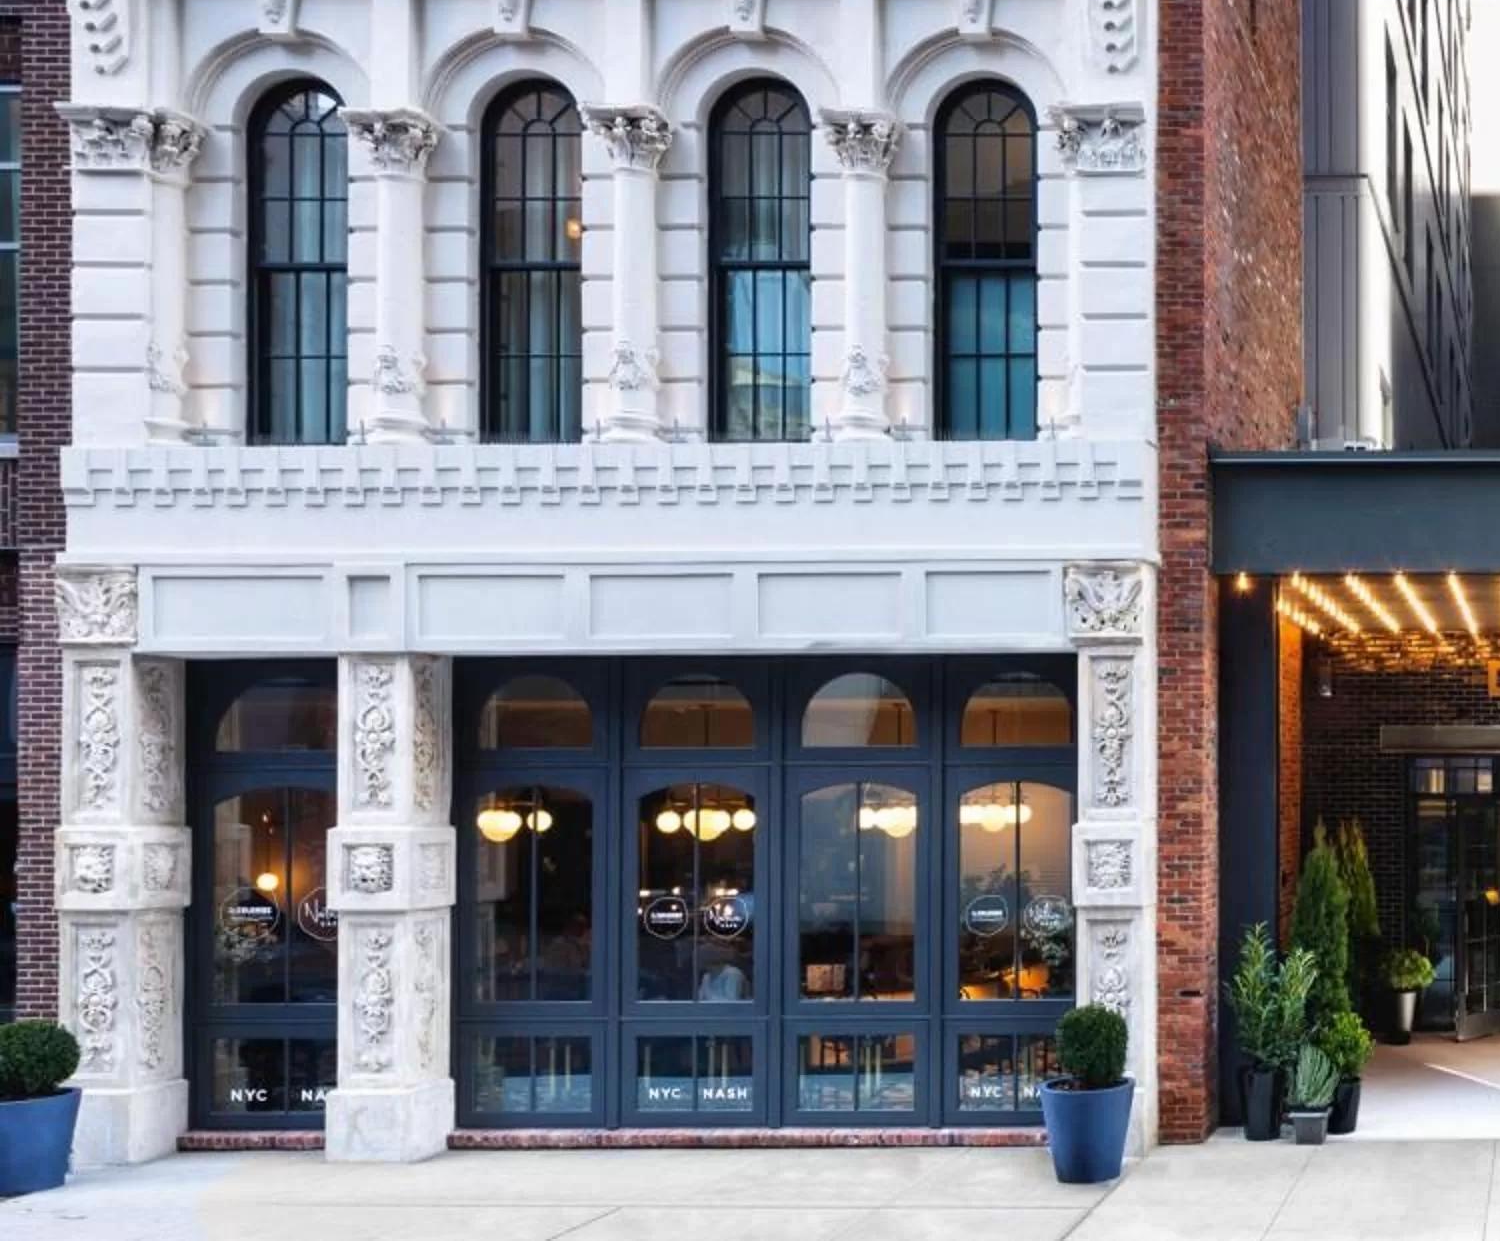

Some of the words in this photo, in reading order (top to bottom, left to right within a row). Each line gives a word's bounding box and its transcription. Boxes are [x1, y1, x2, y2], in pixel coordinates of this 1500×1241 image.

[230, 1088, 268, 1102] NYC
[301, 1089, 327, 1102] NA
[648, 1087, 681, 1100] NYC
[703, 1087, 747, 1100] NASH
[969, 1085, 1003, 1099] NYC
